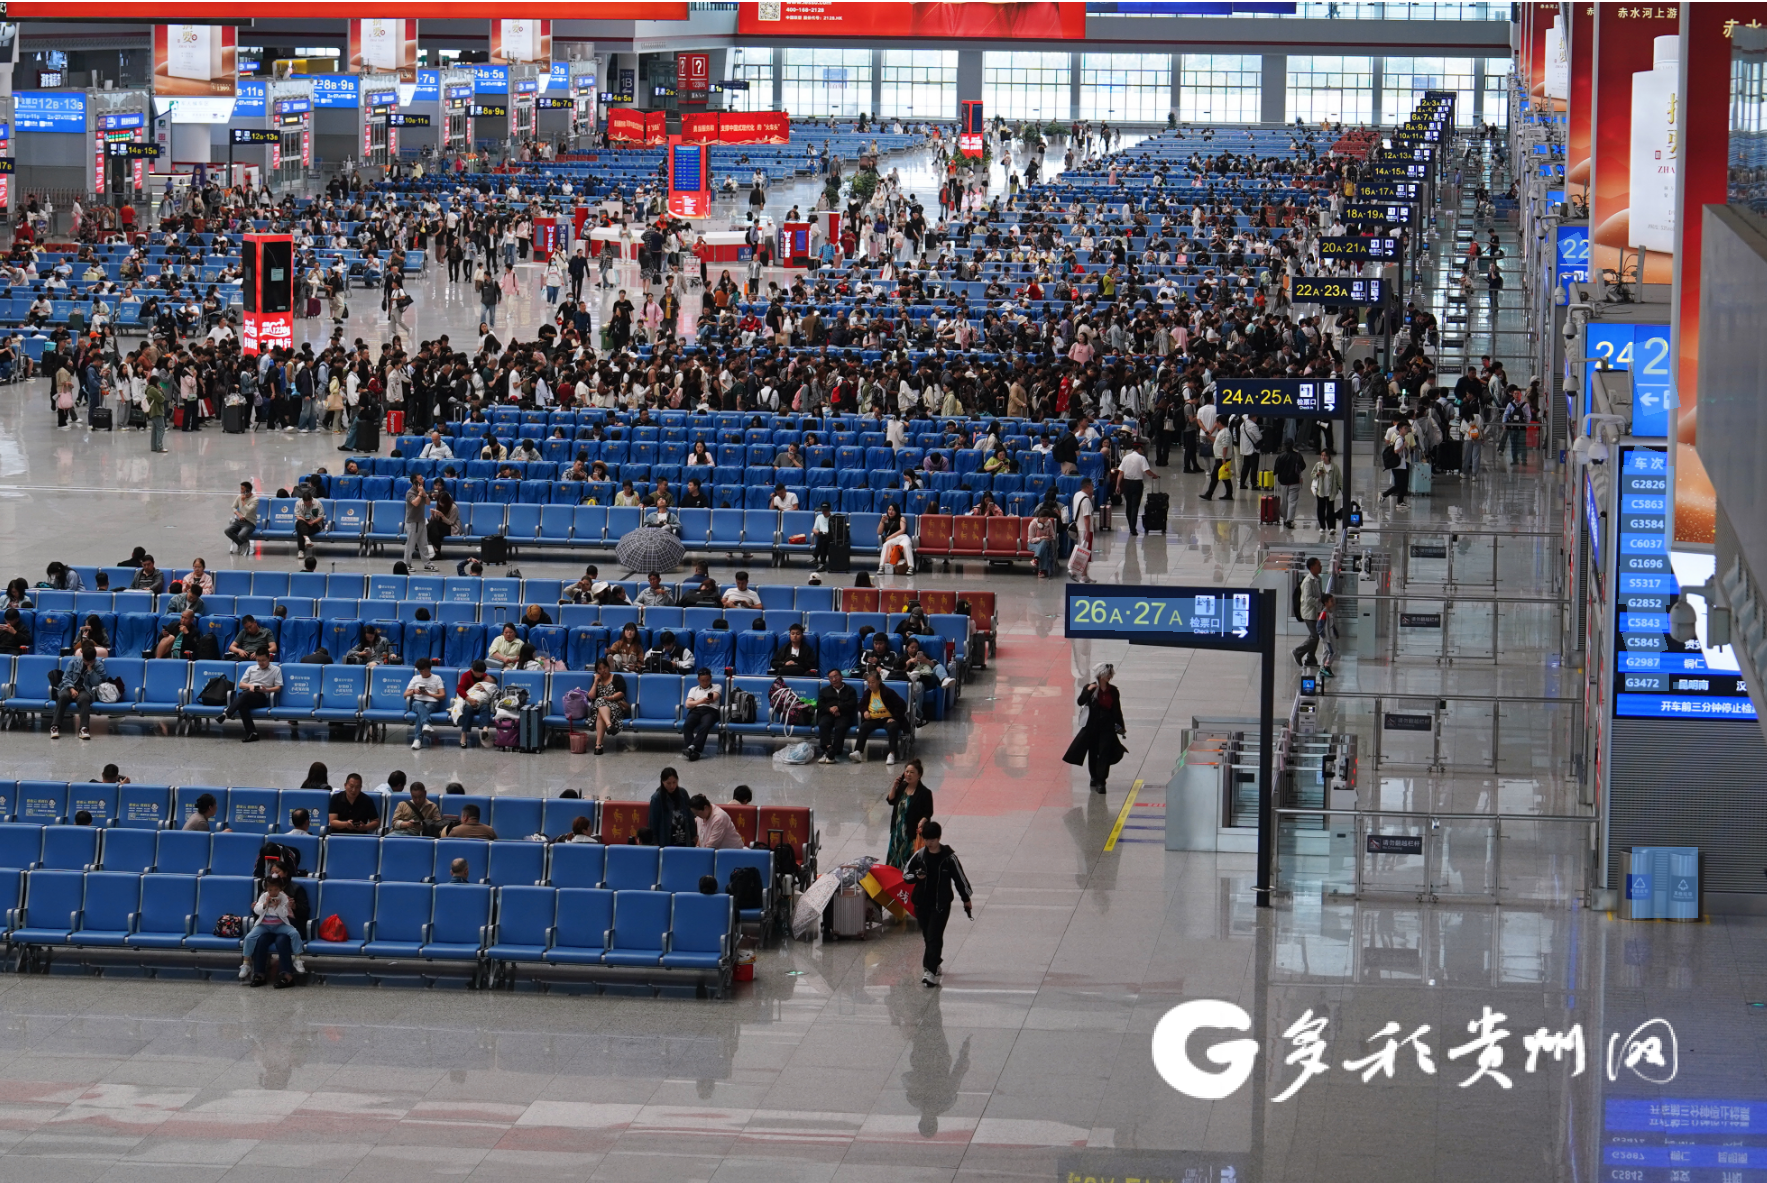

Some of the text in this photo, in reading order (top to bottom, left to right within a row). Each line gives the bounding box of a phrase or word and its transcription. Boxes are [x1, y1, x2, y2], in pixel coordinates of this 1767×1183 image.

[1618, 7, 1678, 19] 赤水河上游
[39, 98, 83, 110] 12B·13B
[1361, 187, 1394, 196] 16A·17A
[1346, 209, 1384, 219] 18A·19A
[1322, 242, 1366, 253] 20A·21A
[1296, 284, 1348, 296] 22A·23A
[1222, 389, 1292, 404] 24A·25A
[1634, 457, 1664, 469] 车次
[1631, 480, 1665, 489] G2826
[1631, 500, 1664, 508] C5863
[1630, 520, 1664, 528] G3584
[1630, 539, 1662, 548] C6037
[1629, 559, 1663, 568] G1696
[1630, 579, 1661, 587] S5317
[1628, 599, 1662, 608] G2852
[1074, 599, 1183, 625] 26A·27A
[1190, 617, 1220, 628] 检票口
[1628, 619, 1660, 627] C5843
[1628, 638, 1660, 647] C5845
[1627, 658, 1660, 667] G2987
[1626, 679, 1659, 687] G3472
[1678, 680, 1709, 690] 昆明南
[1661, 701, 1756, 713] 开车前三分钟停止检
